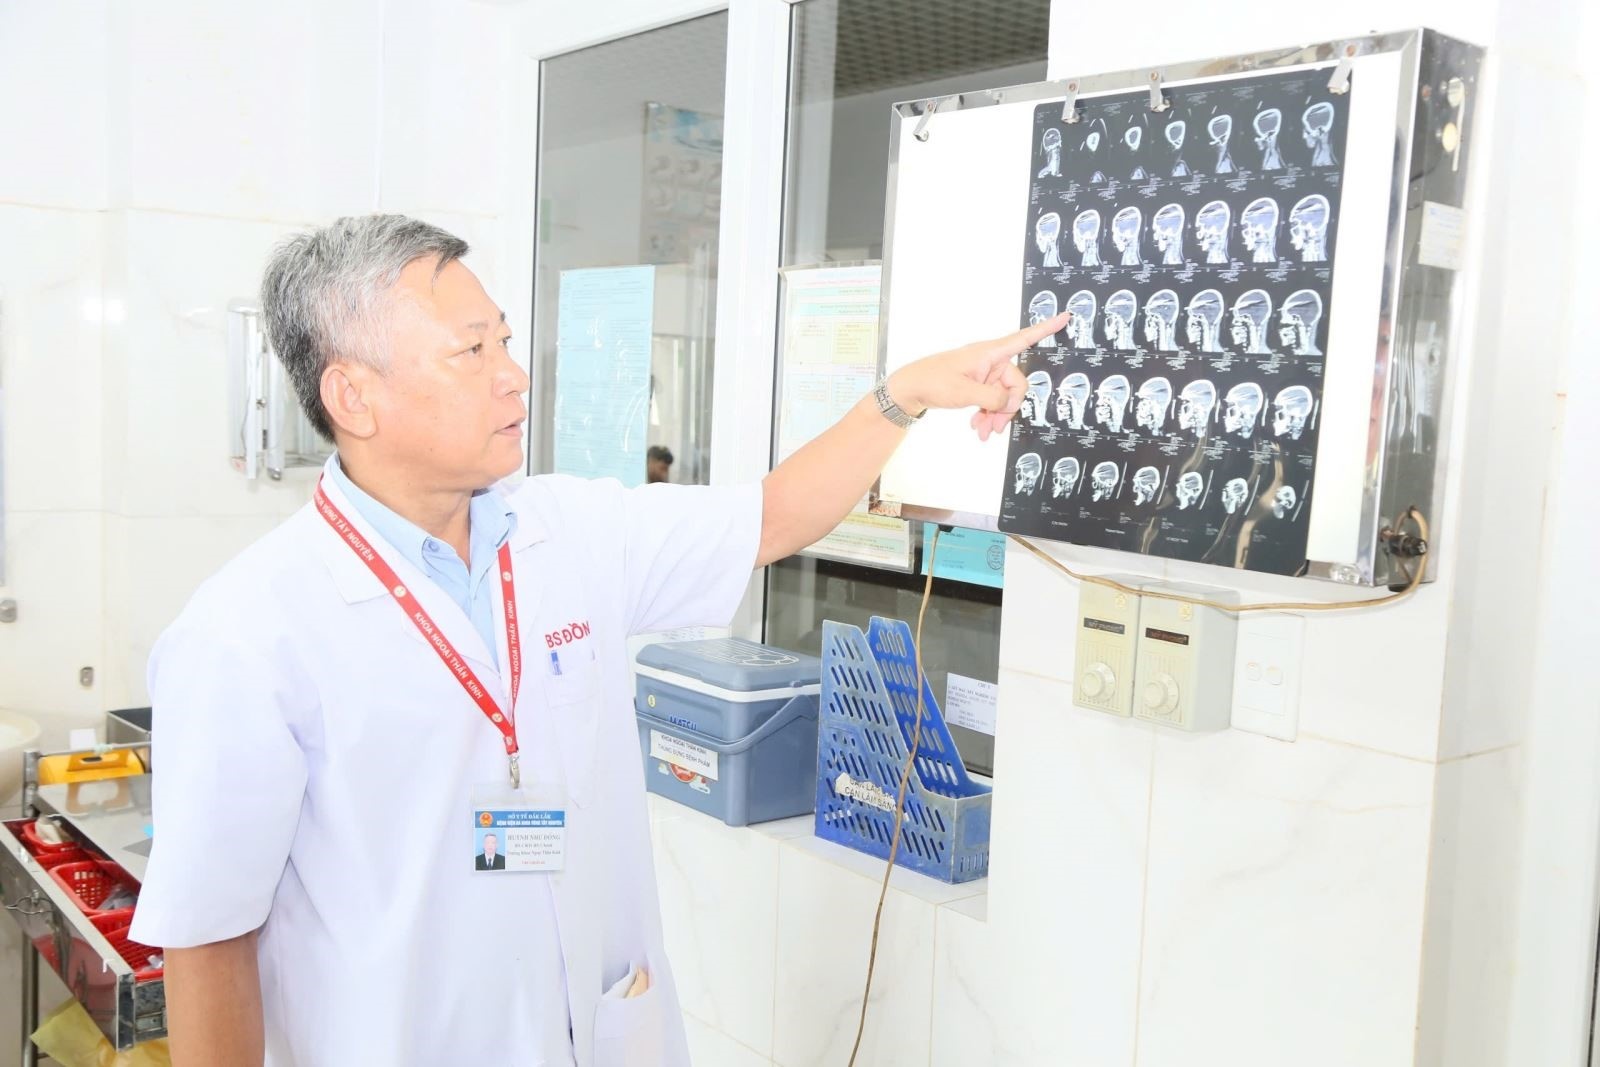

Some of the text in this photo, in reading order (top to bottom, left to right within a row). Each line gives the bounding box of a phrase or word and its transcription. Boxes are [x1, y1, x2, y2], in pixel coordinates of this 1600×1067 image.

[414, 612, 433, 635] KHOA
[466, 679, 484, 699] KINH
[545, 631, 563, 649] BS
